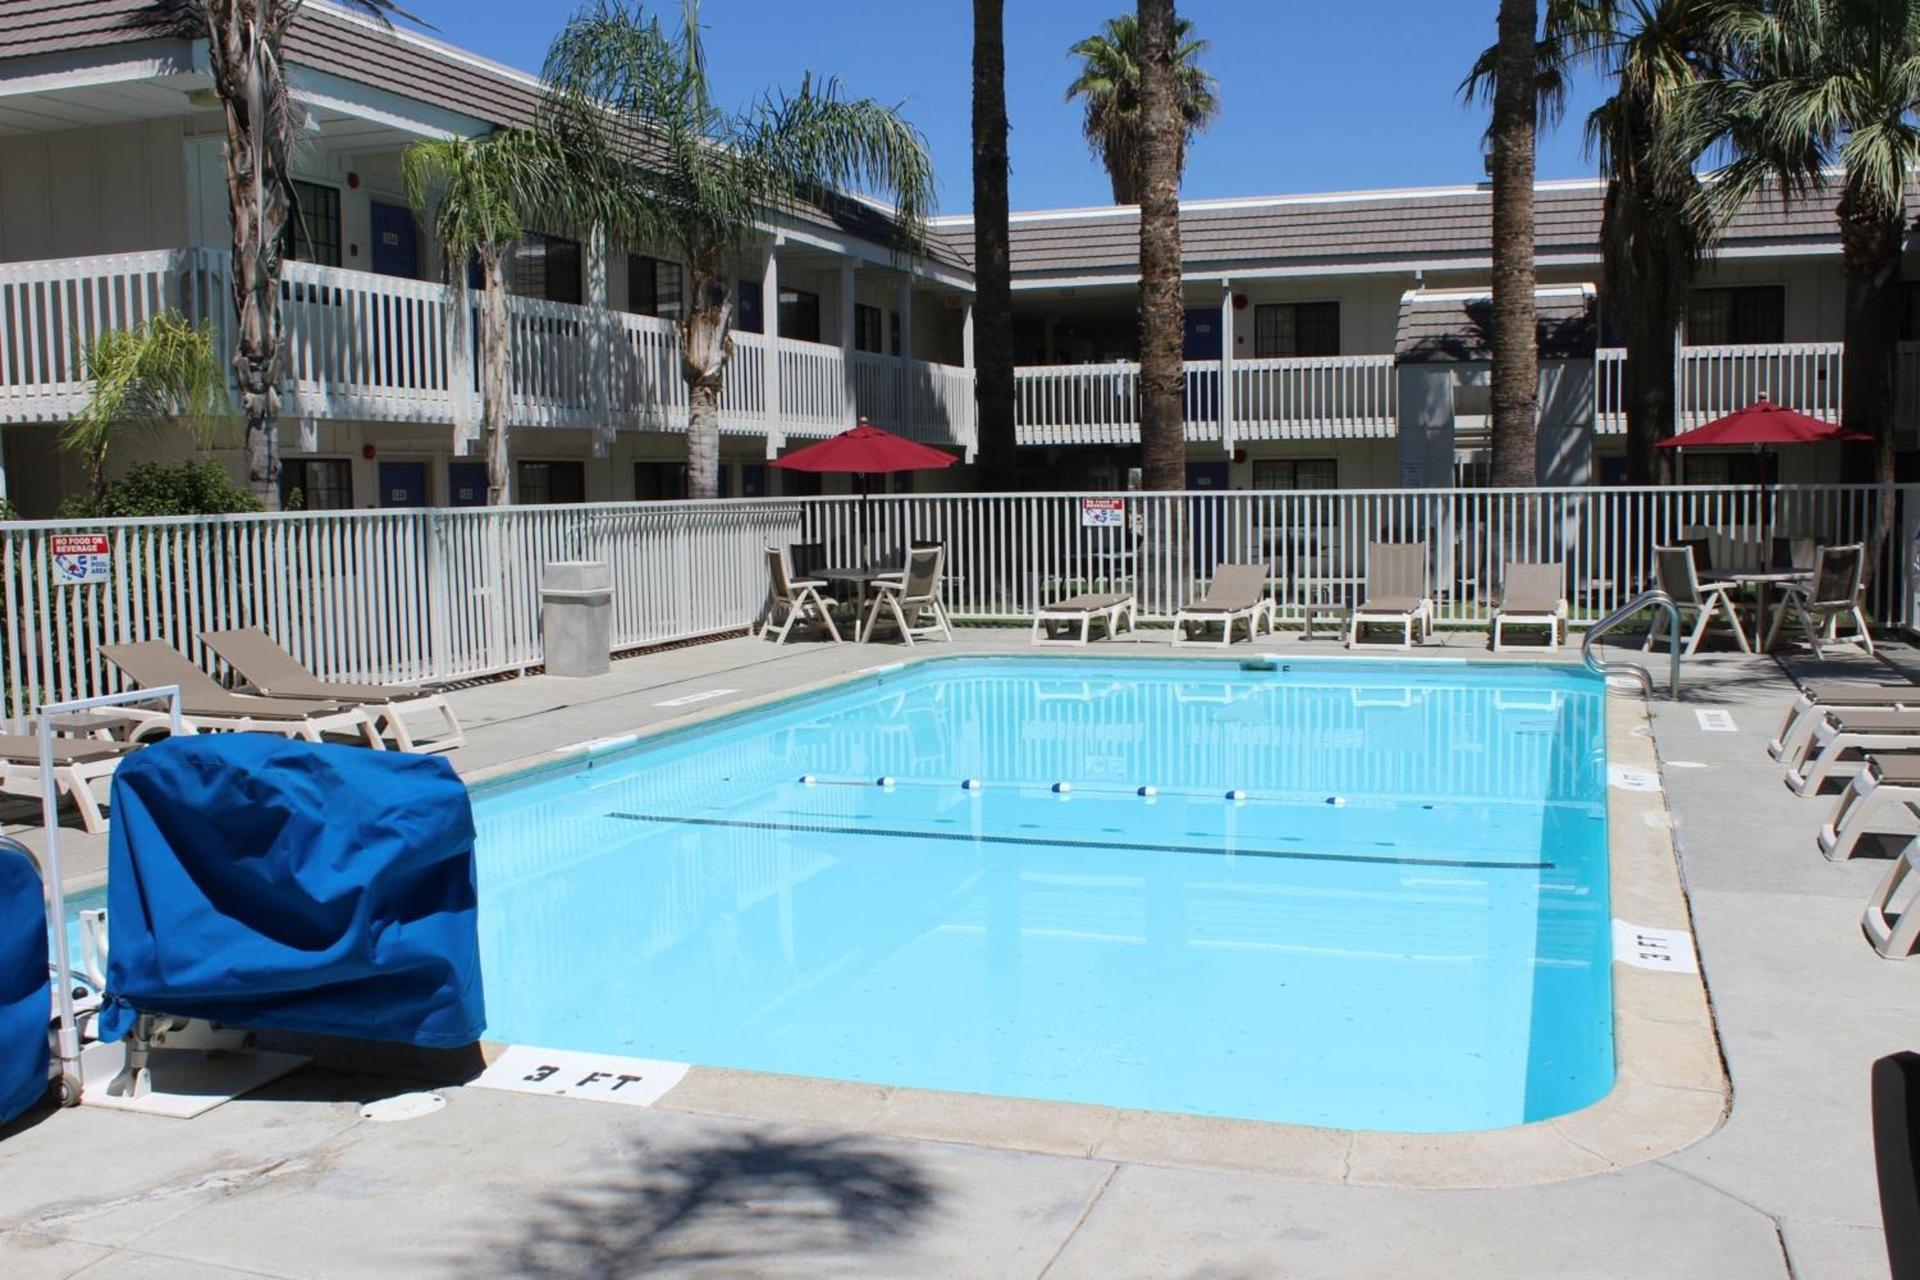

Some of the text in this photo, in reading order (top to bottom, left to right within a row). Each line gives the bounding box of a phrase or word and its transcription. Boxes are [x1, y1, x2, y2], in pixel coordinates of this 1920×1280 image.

[56, 545, 98, 553] BEVERAGE
[69, 537, 90, 545] FOOD
[1637, 934, 1671, 961] 3 FT
[523, 1065, 643, 1091] 3 FT
